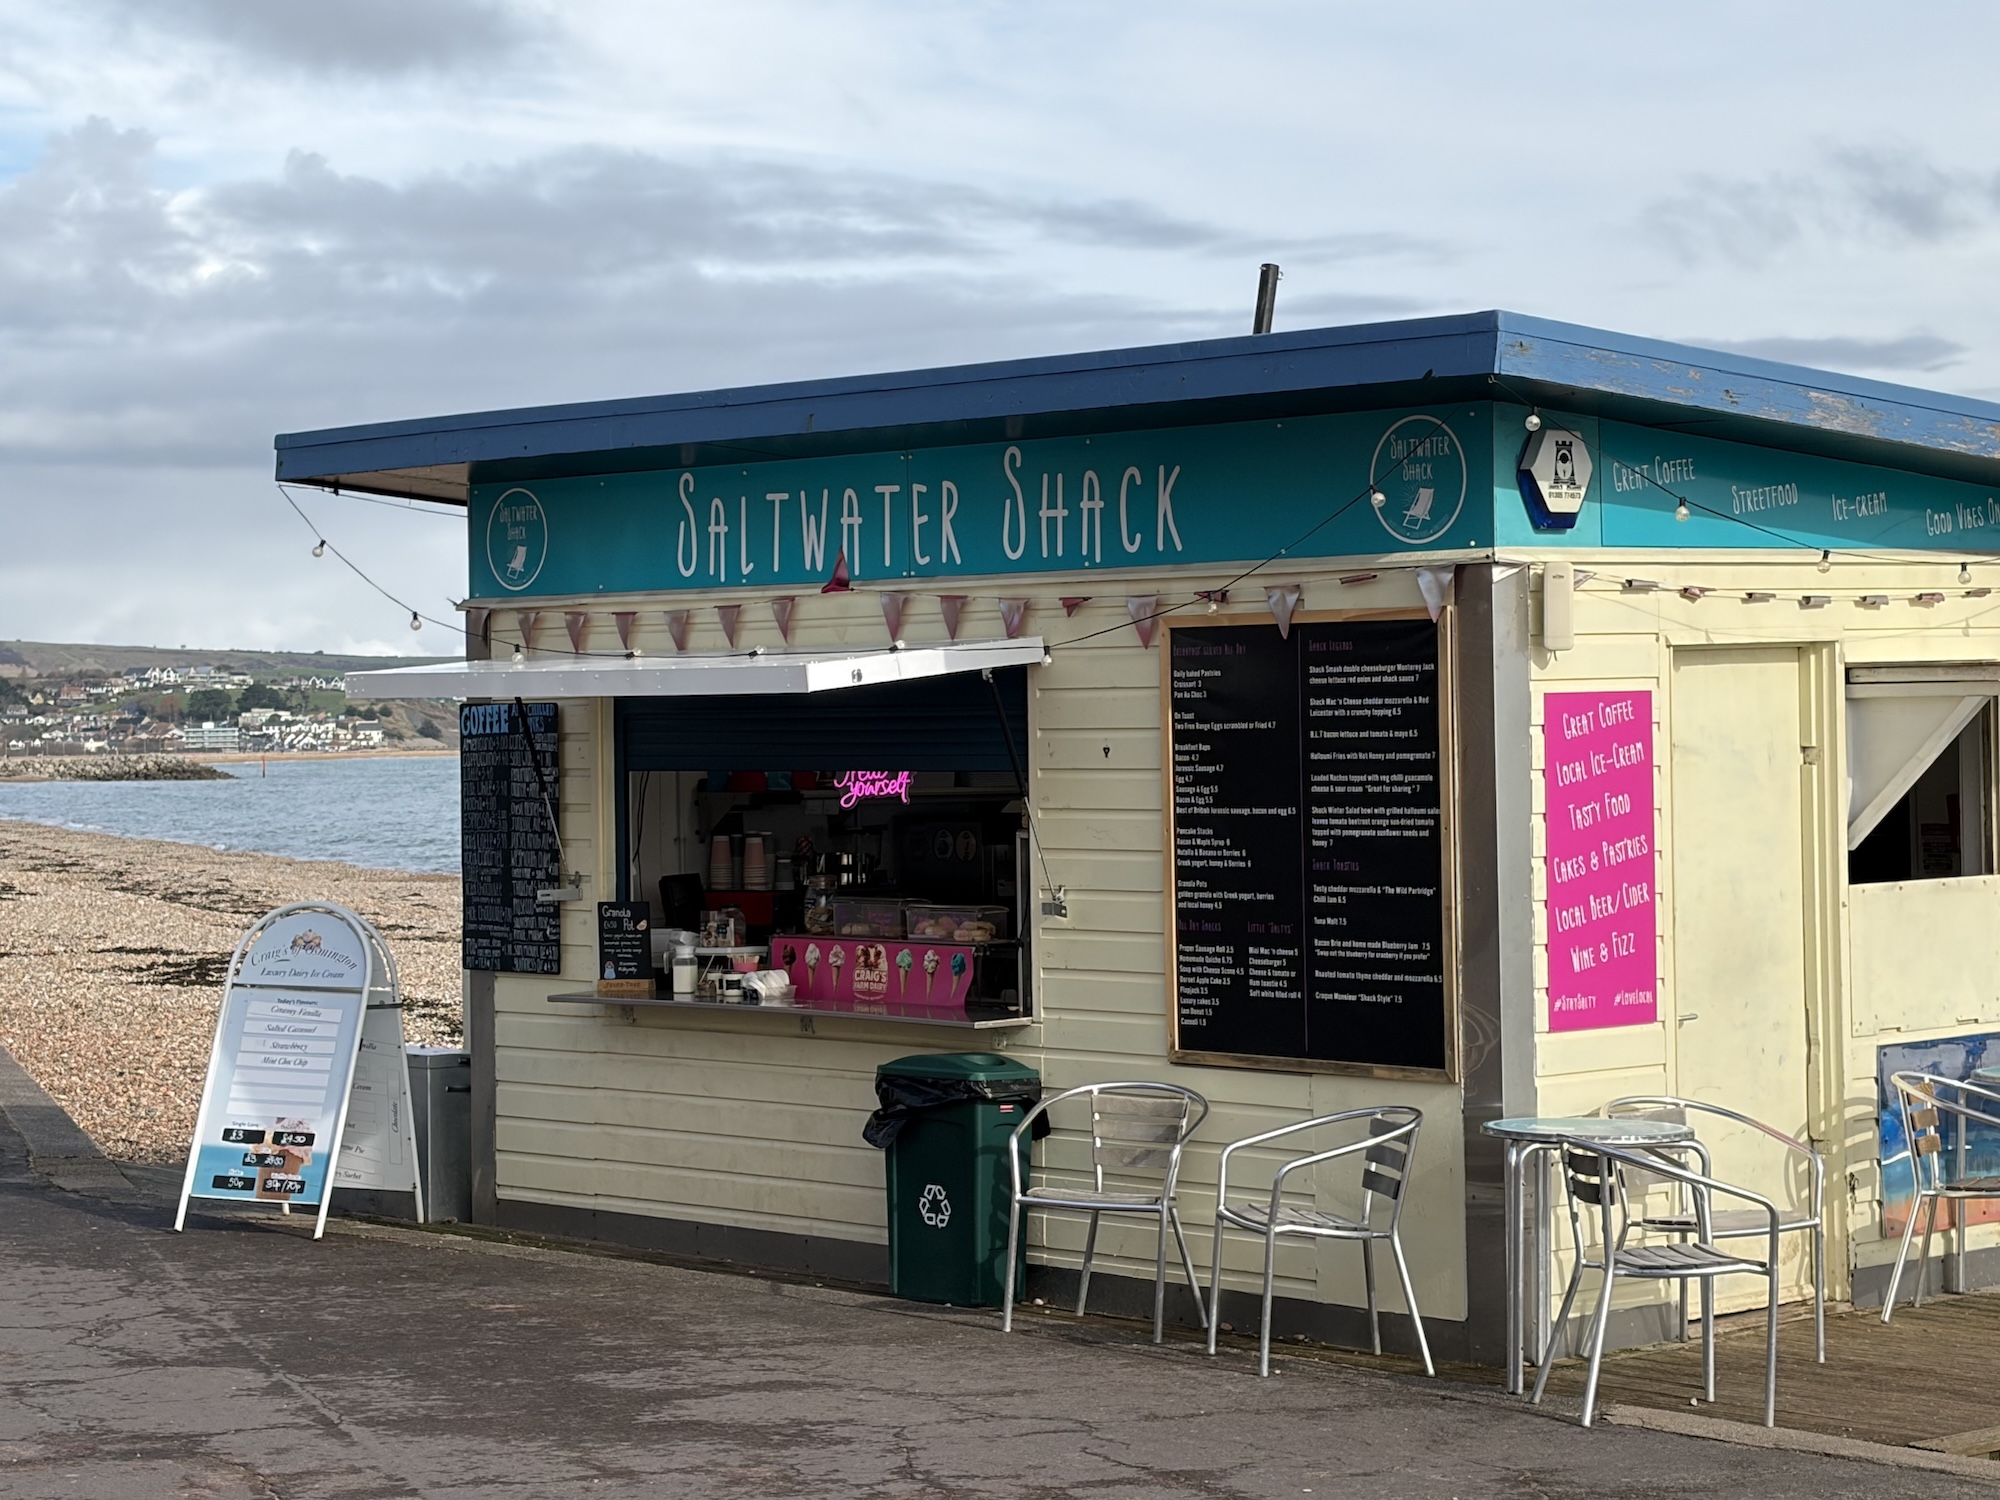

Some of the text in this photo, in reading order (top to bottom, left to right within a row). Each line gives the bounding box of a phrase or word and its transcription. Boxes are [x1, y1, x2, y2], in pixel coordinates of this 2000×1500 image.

[1390, 434, 1450, 459] SALTWATER
[1403, 460, 1433, 481] SHACK
[1613, 460, 1649, 492] GREAT
[1654, 456, 1696, 485] COFFEE
[1732, 482, 1799, 515] STREETFOOD
[1832, 491, 1888, 521] ICE-CREAM
[1926, 508, 1952, 537] GOOD
[1955, 502, 1984, 530] VIBES
[678, 445, 1182, 582] SALTWATER SHACK
[507, 524, 526, 540] SHACK
[461, 704, 509, 736] COFFEE
[1211, 722, 1223, 731] Eggs
[1254, 721, 1268, 729] Fried
[1562, 699, 1635, 740] GREAT COFFEE
[1556, 740, 1645, 787] LOCAL ICE-CREAM
[1568, 792, 1631, 832] TASTY FOOD
[1554, 834, 1648, 884] CAKES & PASTRIES
[602, 905, 631, 917] Granola
[1555, 882, 1650, 933] LOCAL BEER/CIDER
[623, 919, 634, 931] Pot
[251, 945, 291, 966] Craig's
[305, 945, 358, 970] Osmington
[1570, 931, 1636, 974] WINE & FIZZ
[261, 968, 344, 978] Luxury Dairy Ice Cream
[855, 970, 886, 982] CRAIG'S
[870, 982, 885, 991] DAIRY
[270, 1041, 309, 1053] Strawberry
[229, 1130, 243, 1140] £3
